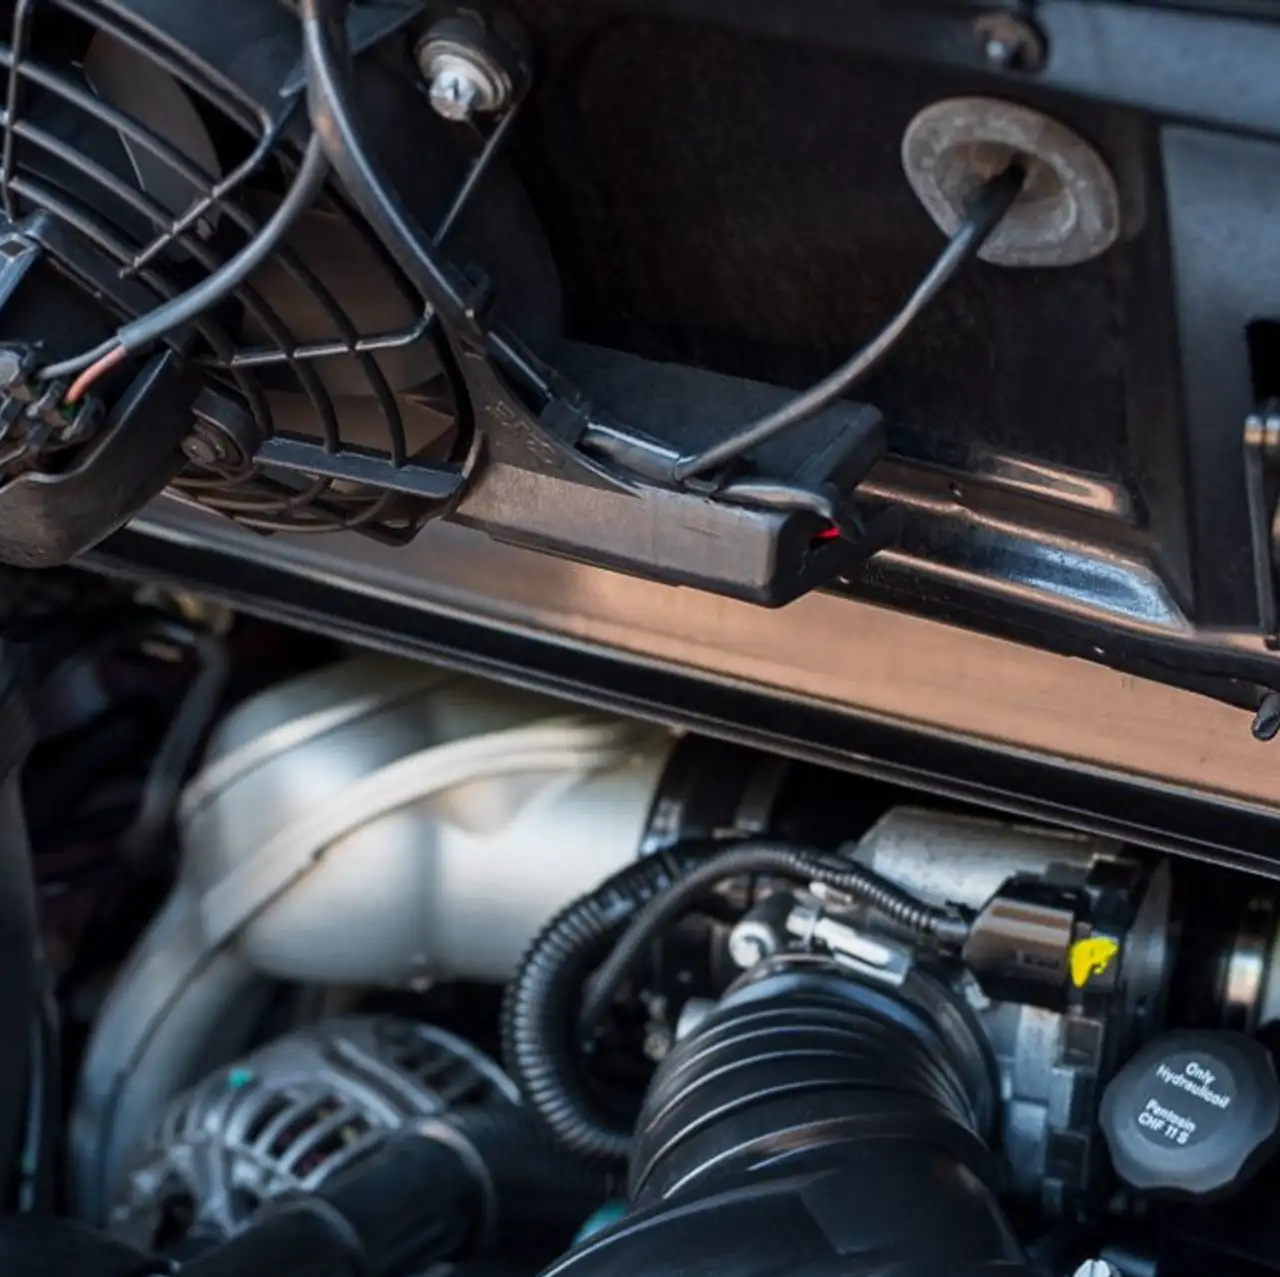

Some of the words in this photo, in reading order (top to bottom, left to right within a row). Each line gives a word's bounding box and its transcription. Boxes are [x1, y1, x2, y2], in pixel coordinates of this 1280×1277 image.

[1156, 1064, 1231, 1109] Hydraulicoil
[1185, 1063, 1216, 1084] Only
[1138, 1112, 1165, 1131] CHF
[1166, 1124, 1179, 1139] 11
[1146, 1099, 1196, 1132] Pentosin
